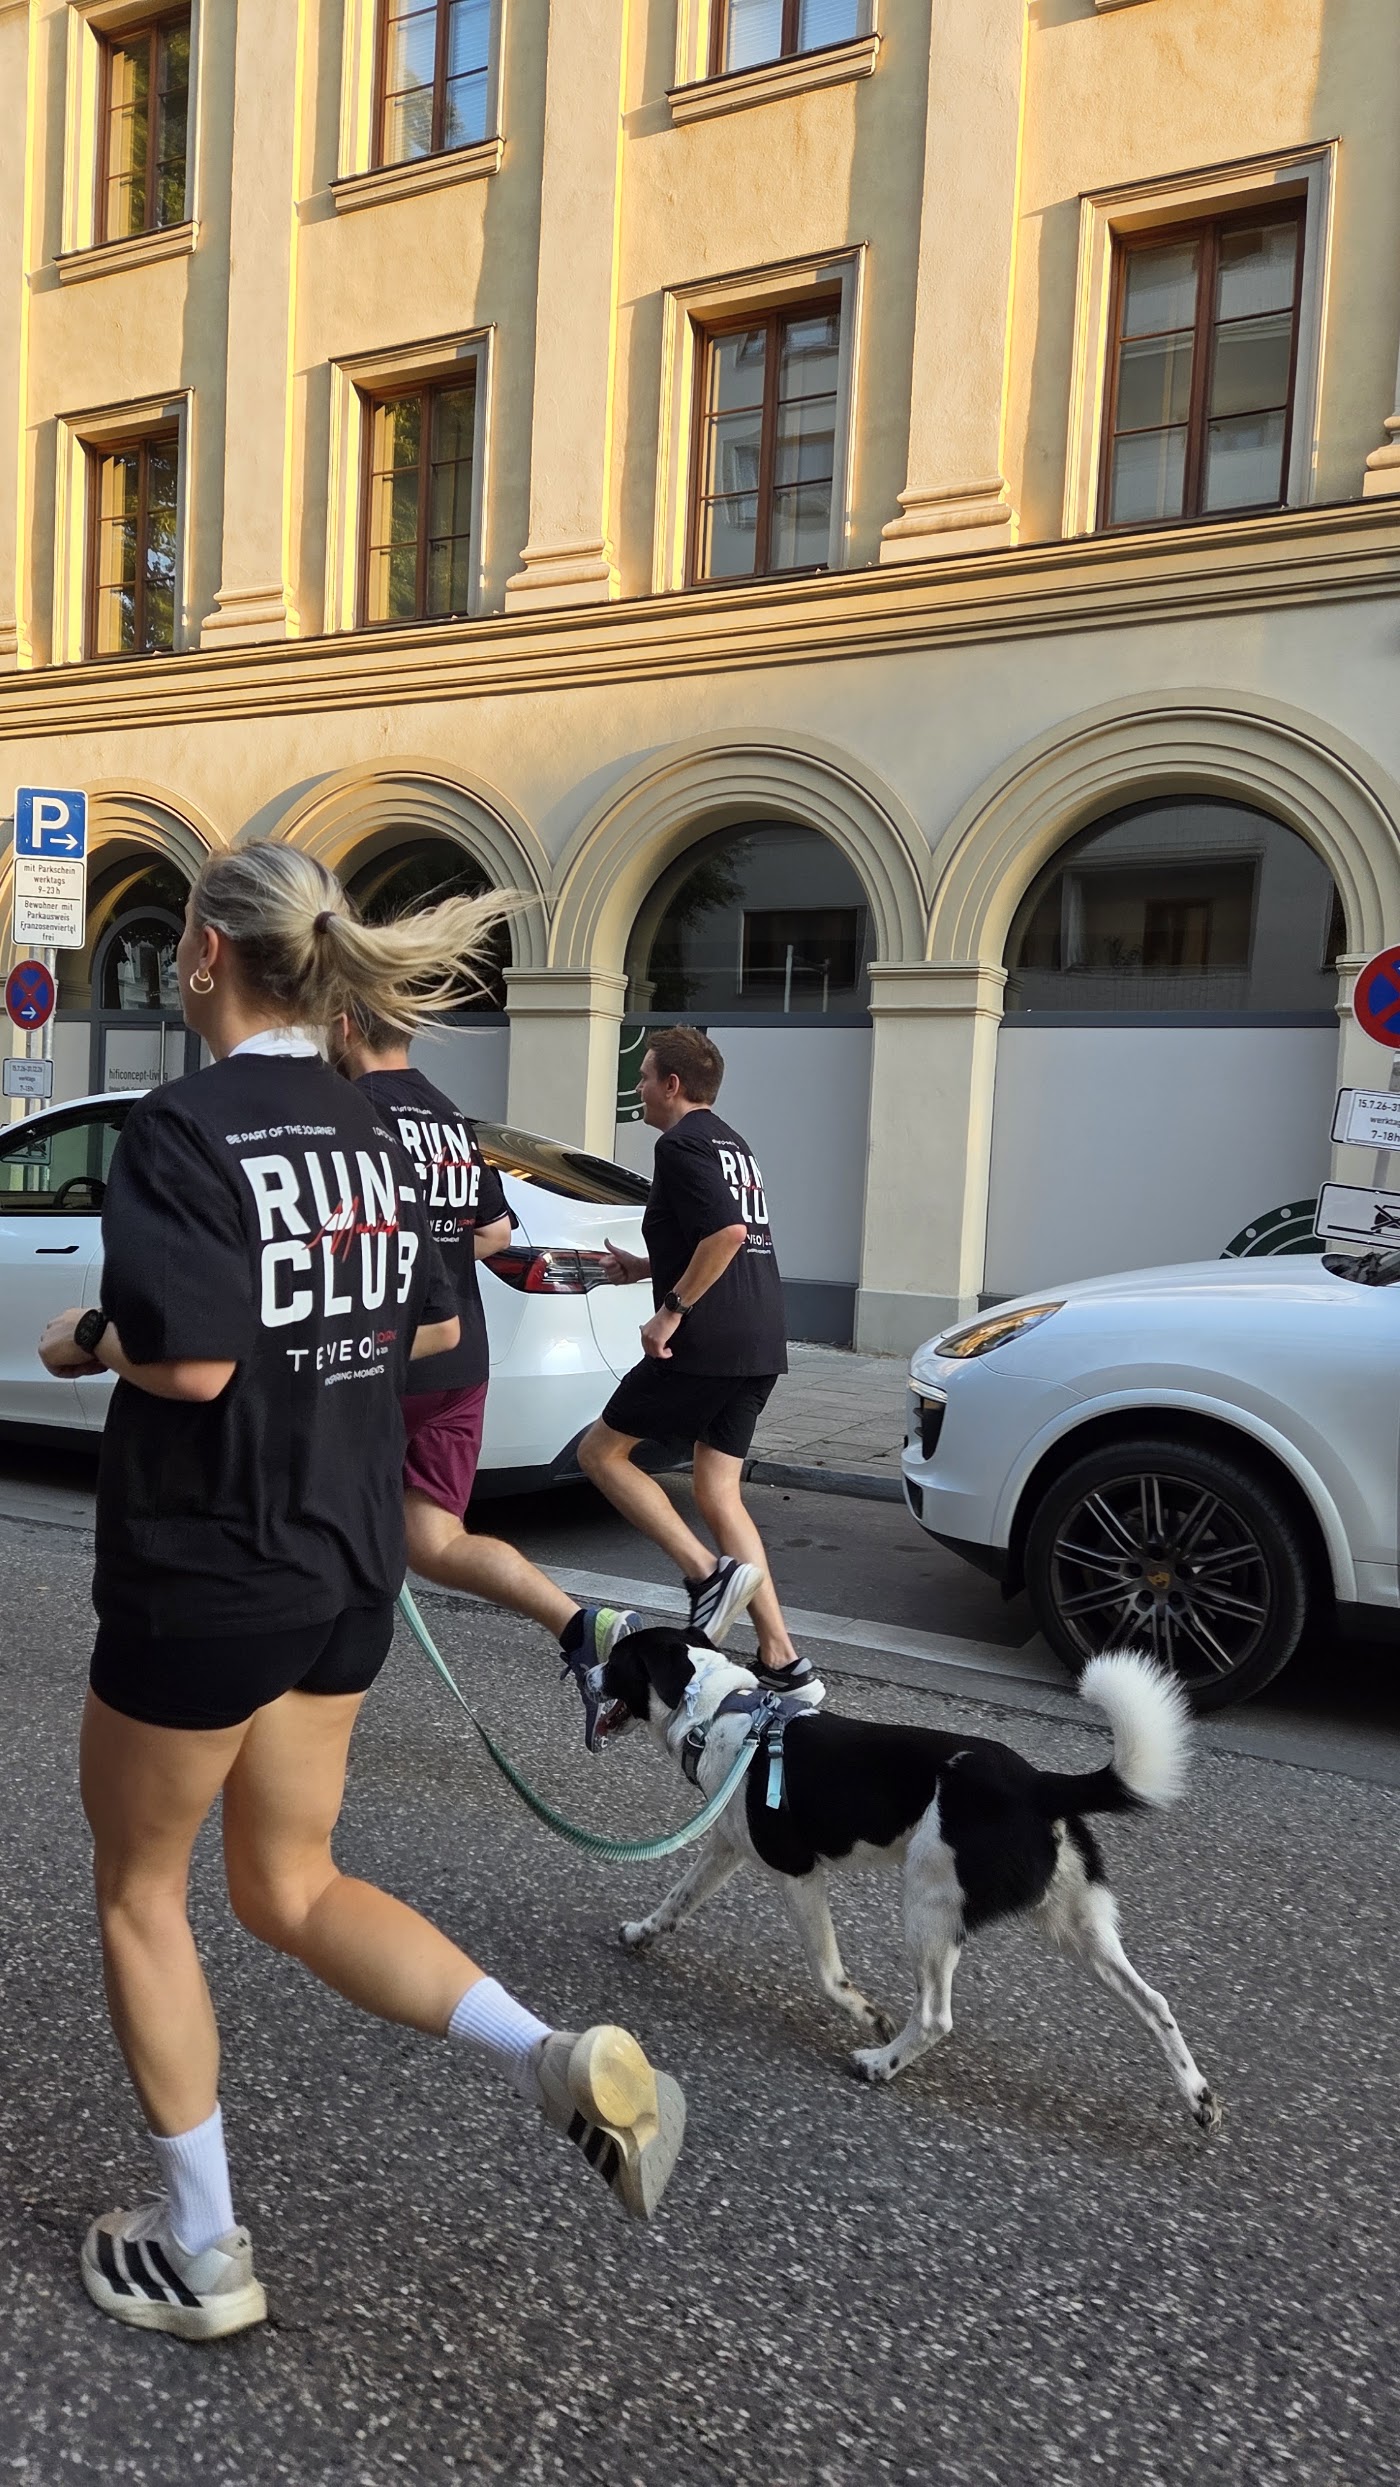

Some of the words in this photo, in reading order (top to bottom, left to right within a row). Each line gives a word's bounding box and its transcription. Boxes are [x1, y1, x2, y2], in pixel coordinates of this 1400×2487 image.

[32, 796, 70, 848] P
[24, 864, 36, 872] mit
[38, 864, 76, 875] Parkschein
[33, 876, 66, 886] werktags
[38, 886, 55, 894] 9-23
[24, 900, 59, 910] Bewohner
[61, 903, 73, 911] mit
[27, 911, 70, 921] Parkausweis
[20, 920, 77, 933] Franzosenviertel
[42, 933, 55, 941] frei
[241, 1129, 267, 1142] PART
[268, 1126, 283, 1138] OF
[283, 1124, 304, 1135] THE
[1371, 1130, 1400, 1142] 7-18h
[260, 1231, 418, 1328] CLUB
